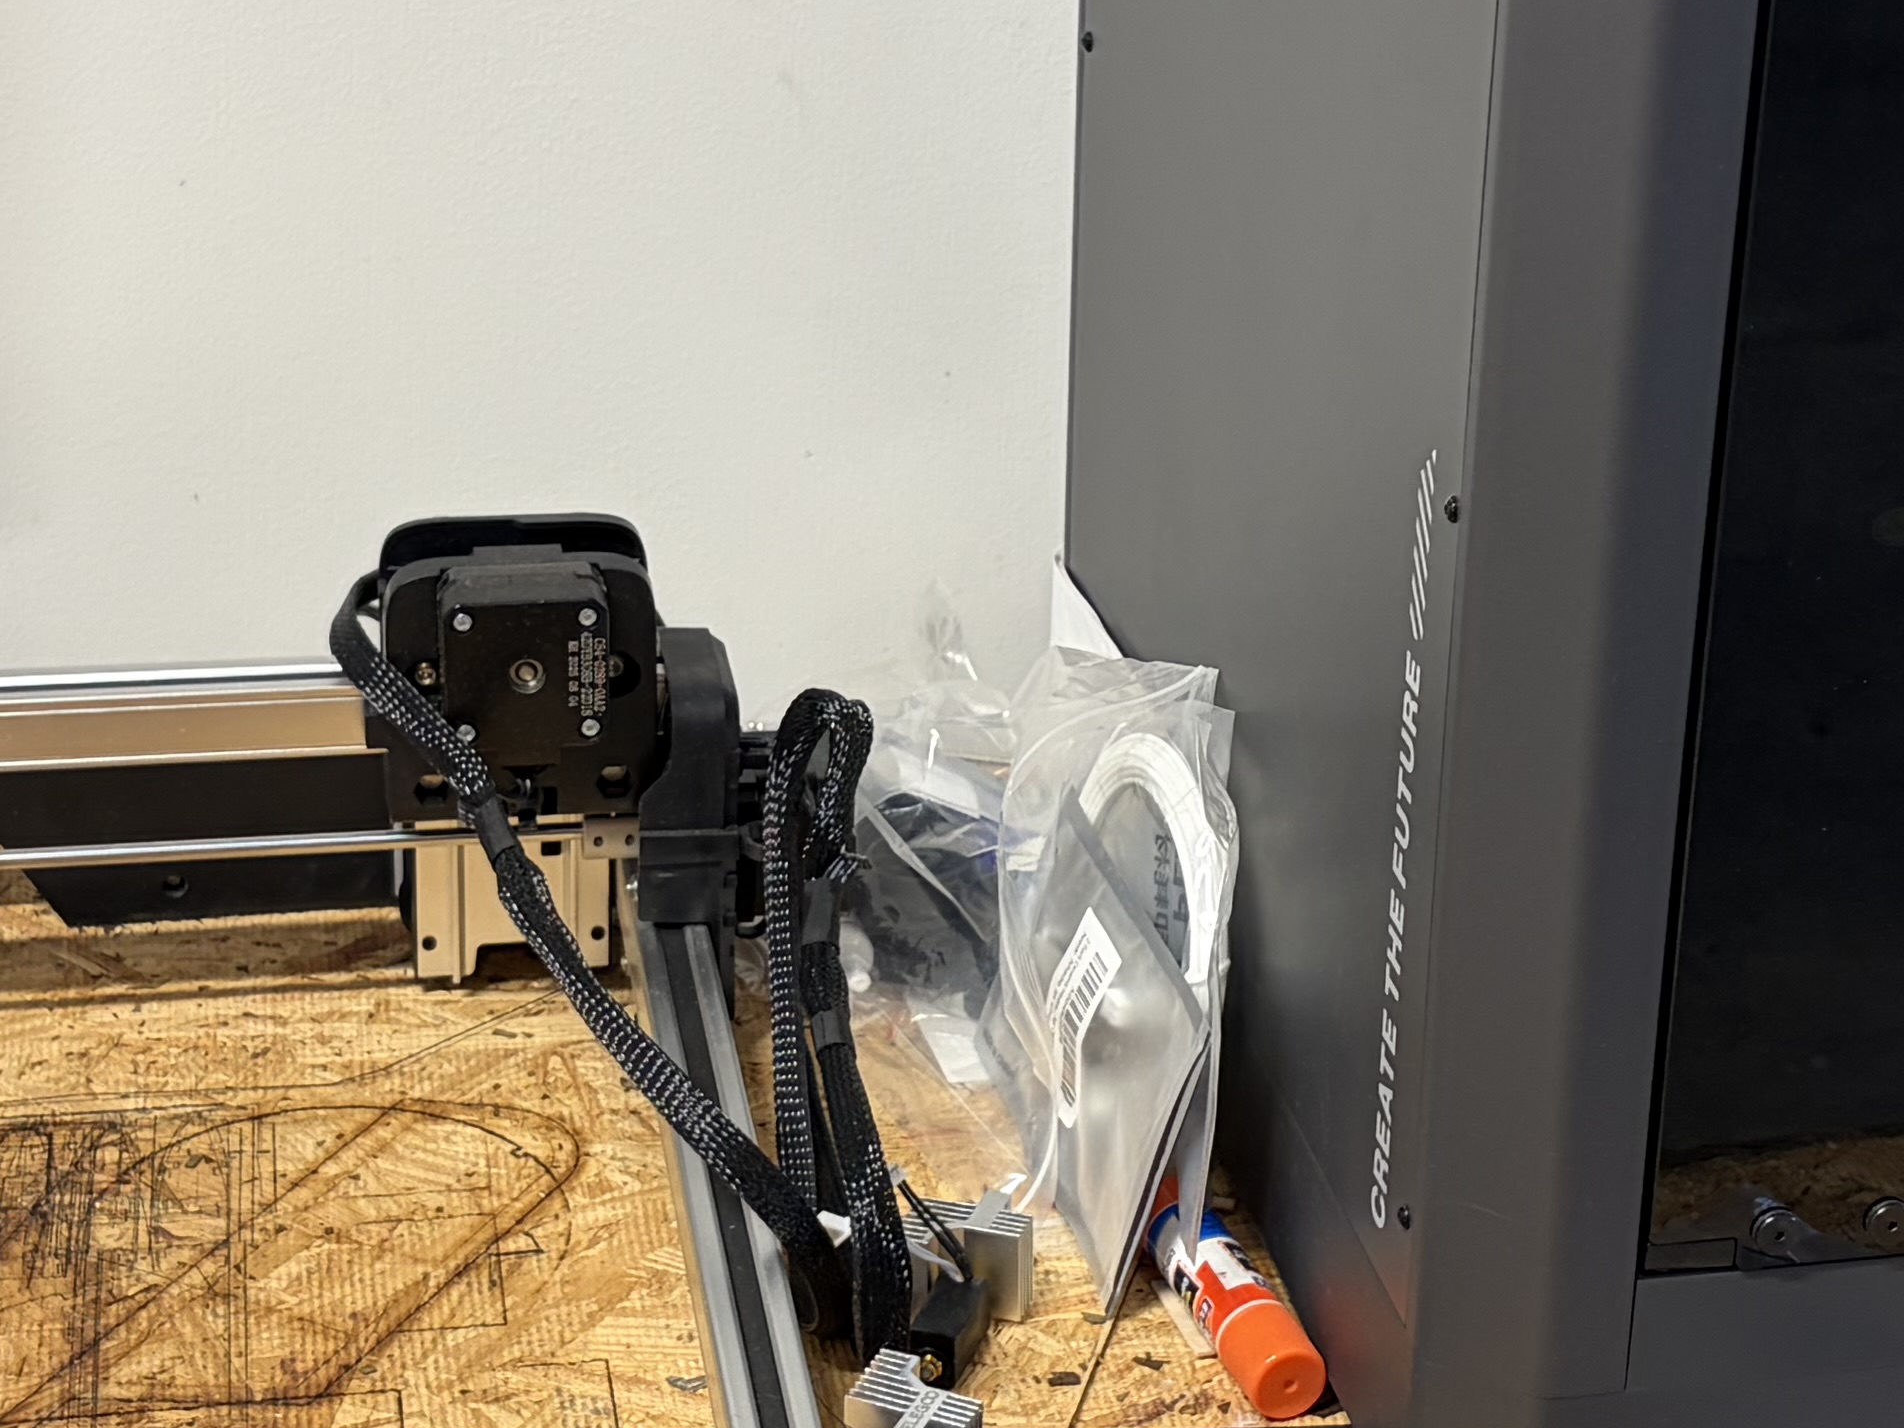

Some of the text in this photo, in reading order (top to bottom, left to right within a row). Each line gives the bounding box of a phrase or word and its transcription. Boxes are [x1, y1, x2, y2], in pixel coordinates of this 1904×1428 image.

[1368, 650, 1424, 1231] CREATE THE FUTURE
